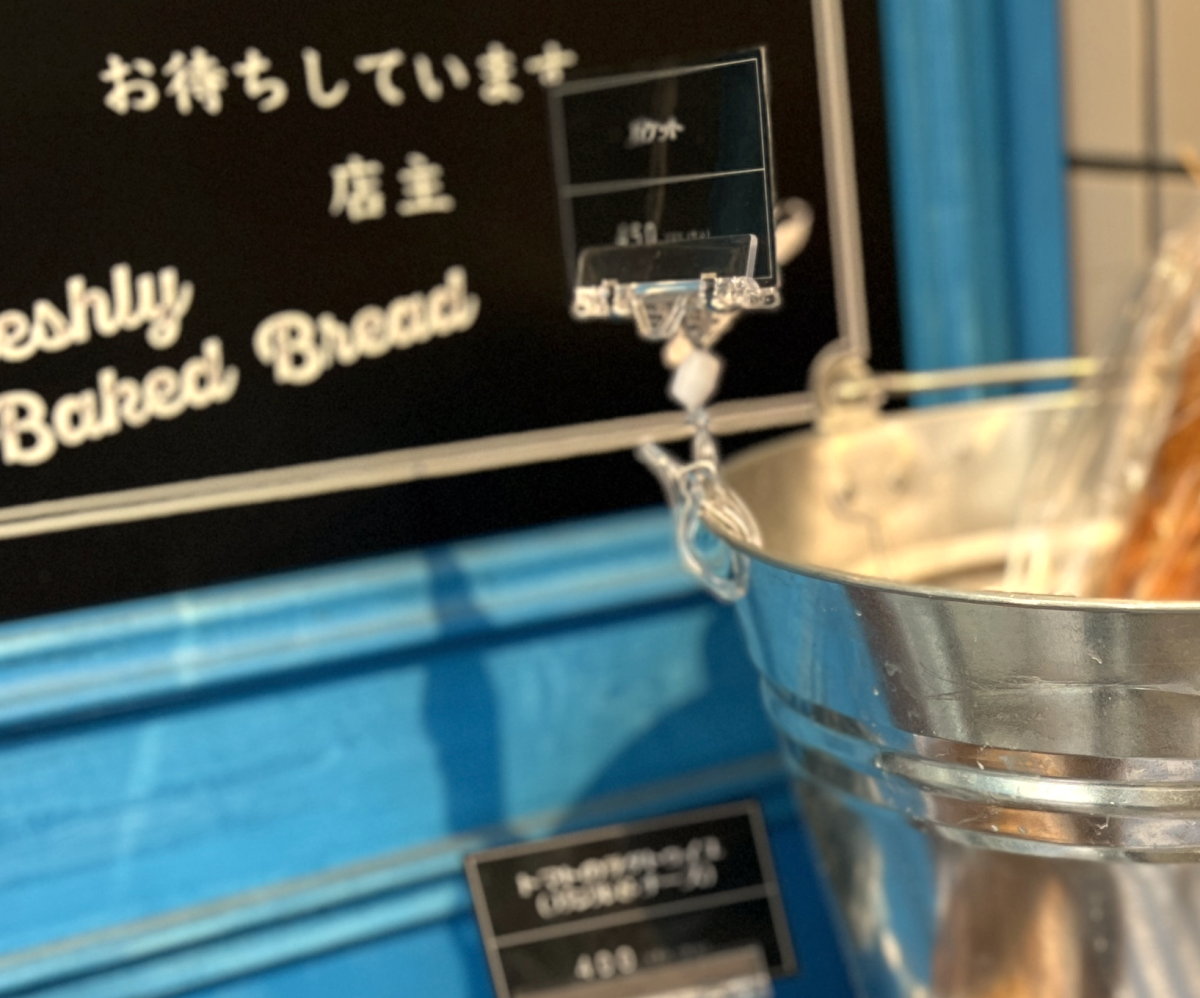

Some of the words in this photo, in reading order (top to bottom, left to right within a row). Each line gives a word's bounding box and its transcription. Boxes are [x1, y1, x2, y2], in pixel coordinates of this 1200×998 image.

[98, 40, 578, 115] お待ちしています
[327, 150, 456, 223] 店主
[0, 335, 239, 467] Baked
[252, 264, 482, 388] Bread
